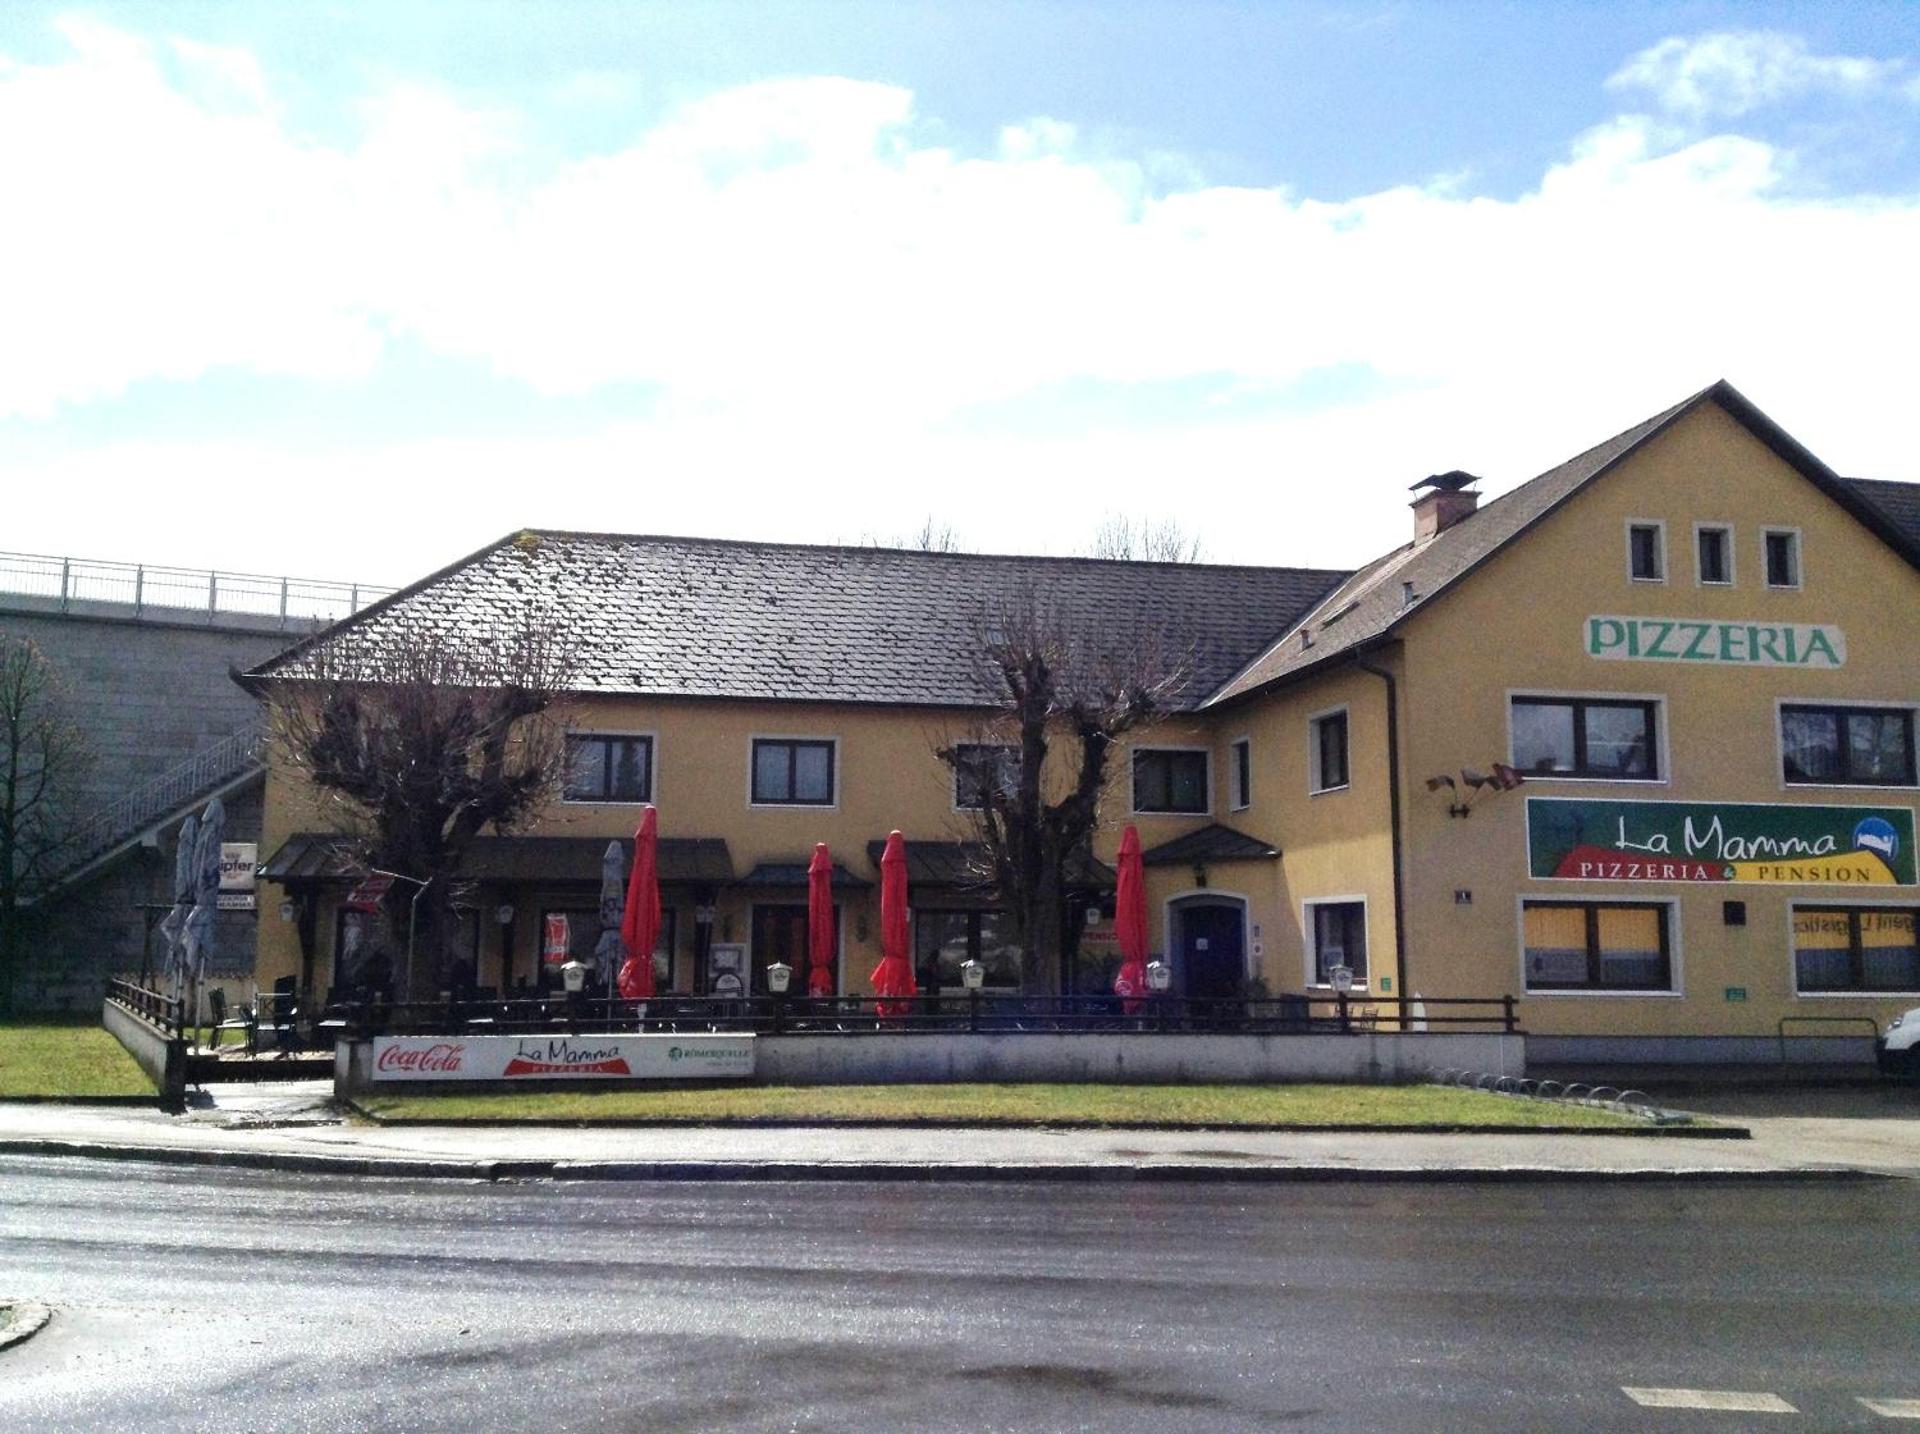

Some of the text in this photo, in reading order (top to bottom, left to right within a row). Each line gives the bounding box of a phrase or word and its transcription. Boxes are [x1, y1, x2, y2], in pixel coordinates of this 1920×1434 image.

[1589, 618, 1841, 665] PIZZERIA
[1615, 814, 1838, 861] La Mamma
[218, 859, 254, 872] ipfer
[1580, 862, 1871, 882] PIZZERIA & PENSION
[513, 1038, 619, 1064] La Mamma
[532, 1063, 603, 1073] PIZZERIA
